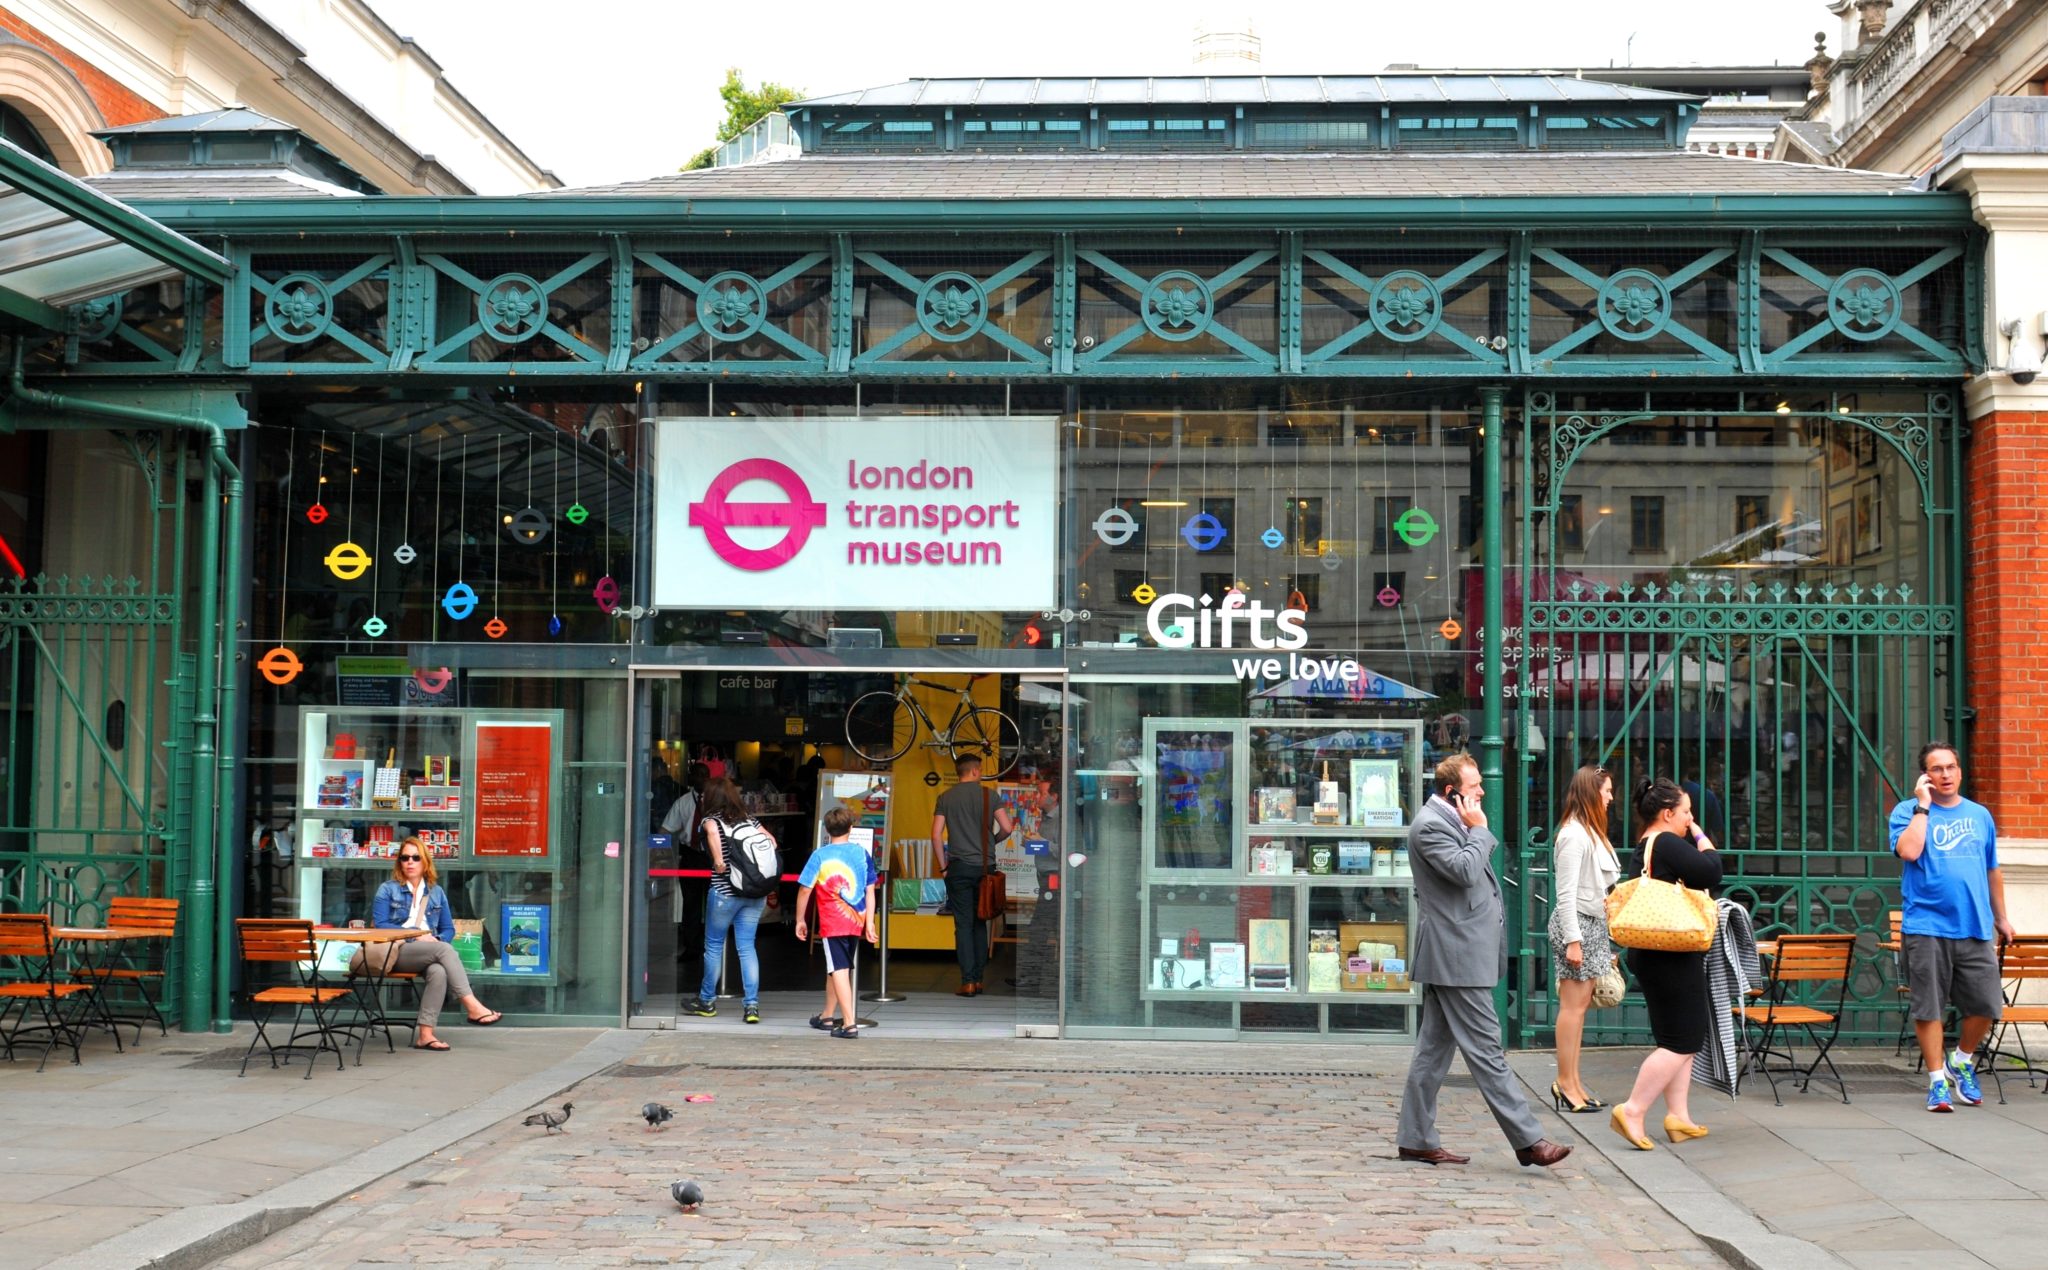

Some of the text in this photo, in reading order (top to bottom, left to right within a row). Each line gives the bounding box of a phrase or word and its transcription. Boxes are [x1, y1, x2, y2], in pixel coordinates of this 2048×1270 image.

[848, 459, 973, 490] london
[846, 499, 1020, 535] transport
[847, 541, 1002, 565] museum
[1146, 593, 1308, 650] Gifts
[1232, 653, 1359, 681] we love
[719, 675, 778, 689] cafe bar
